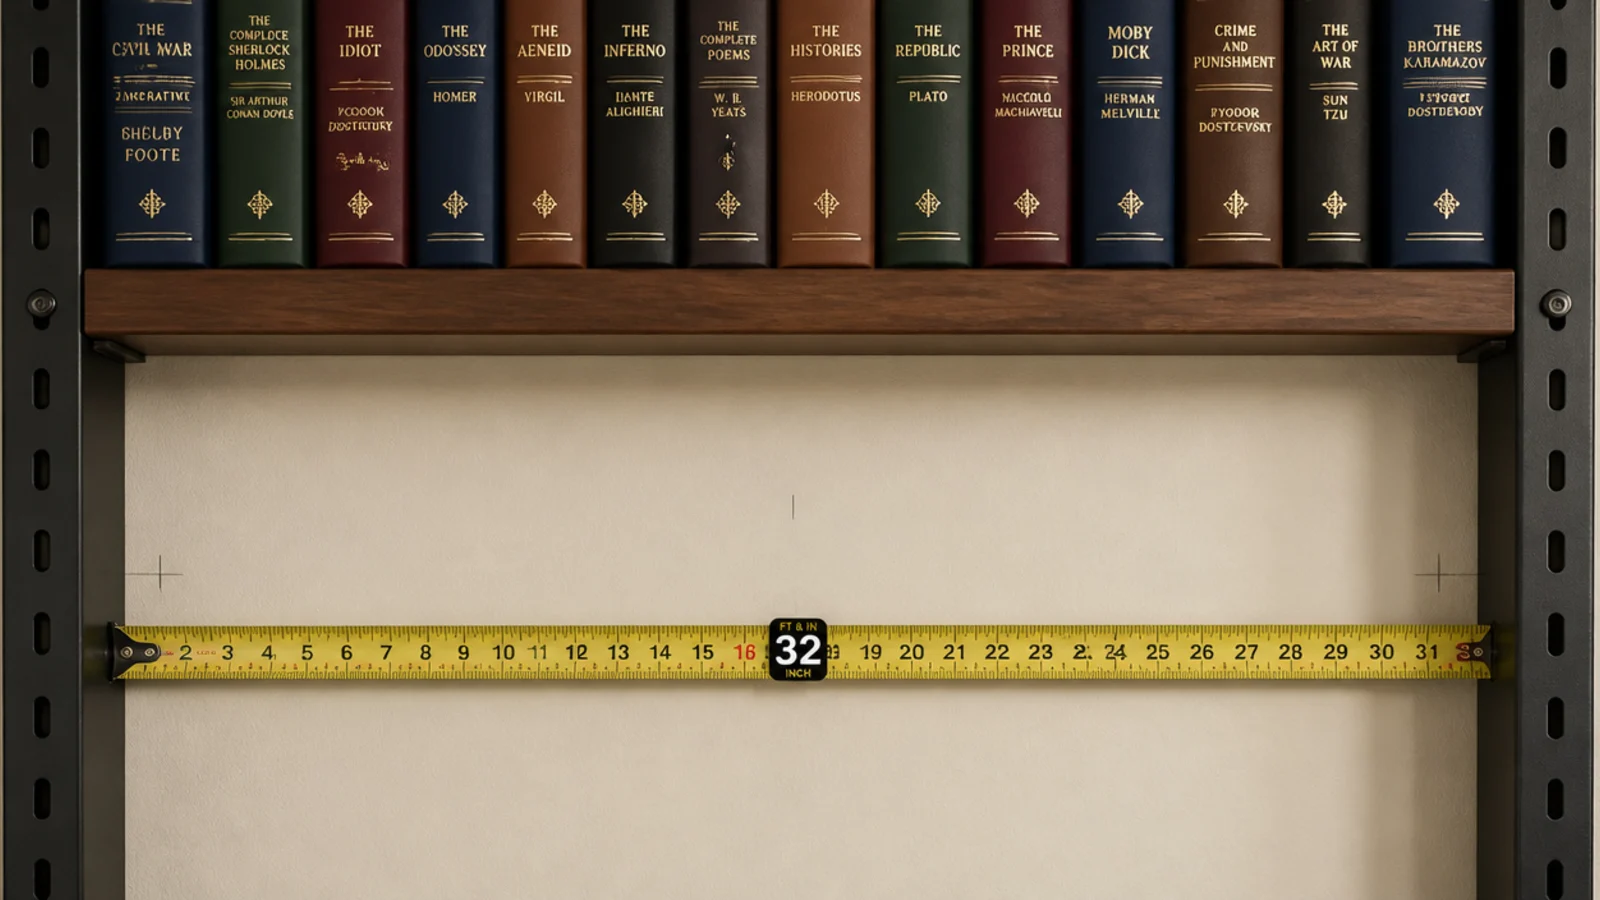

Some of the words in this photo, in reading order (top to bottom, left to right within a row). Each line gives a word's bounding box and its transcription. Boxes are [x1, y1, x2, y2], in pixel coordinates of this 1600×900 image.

[248, 14, 270, 26] THE
[717, 20, 740, 32] THE
[137, 23, 165, 36] THE
[345, 25, 374, 38] THE
[441, 24, 469, 38] THE
[531, 24, 559, 38] THE
[621, 24, 650, 38] THE
[812, 24, 840, 37] THE
[914, 24, 943, 37] THE
[1014, 24, 1043, 38] THE
[1108, 25, 1154, 40] MOBY
[1214, 24, 1257, 37] CRIME
[1322, 23, 1349, 37] THE
[1433, 24, 1462, 37] THE
[700, 34, 758, 46] COMPLETE
[1222, 41, 1249, 52] AND
[1312, 40, 1339, 52] ART
[1341, 40, 1359, 53] OF
[229, 43, 291, 56] SHERLOCK
[339, 43, 382, 57] IDIOT
[517, 43, 572, 57] AENEID
[604, 44, 667, 58] INFERNO
[708, 49, 751, 61] POEMS
[791, 43, 862, 57] HISTORIES
[896, 43, 961, 58] REPUBLIC
[1003, 43, 1054, 58] PRINCE
[1112, 44, 1150, 60] DICK
[235, 58, 286, 70] HOLMES
[1194, 55, 1276, 69] PUNISHMENT
[230, 96, 246, 106] SIR
[433, 91, 477, 103] HOMER
[524, 90, 566, 103] VIRGIL
[791, 90, 861, 103] HERODOTUS
[909, 90, 948, 102] PLATO
[1323, 95, 1348, 106] SUN
[711, 106, 747, 118] YEATS
[1323, 109, 1348, 121] TZU
[125, 147, 181, 162] FOOTE
[778, 621, 794, 633] FT
[805, 621, 818, 633] IN
[179, 645, 192, 660] 2
[222, 645, 234, 660] 3
[261, 645, 273, 660] 4
[301, 645, 313, 660] 5
[341, 645, 353, 660] 6
[380, 645, 392, 660] 7
[420, 645, 431, 660] 8
[458, 645, 469, 660] 9
[493, 645, 515, 660] 10
[527, 645, 547, 660] 11
[566, 645, 588, 660] 12
[608, 645, 629, 660] 13
[649, 645, 671, 660] 14
[692, 645, 714, 660] 15
[734, 645, 756, 660] 16
[775, 634, 821, 666] 32
[860, 644, 882, 660] 19
[900, 644, 924, 660] 20
[943, 644, 965, 660] 21
[985, 644, 1009, 660] 22
[1029, 644, 1053, 660] 23
[1146, 645, 1169, 660] 25
[1190, 645, 1214, 660] 26
[1235, 645, 1258, 660] 27
[1279, 645, 1303, 660] 28
[1324, 645, 1348, 660] 29
[1370, 645, 1394, 660] 30
[1415, 645, 1438, 660] 31
[784, 667, 813, 679] INCH
